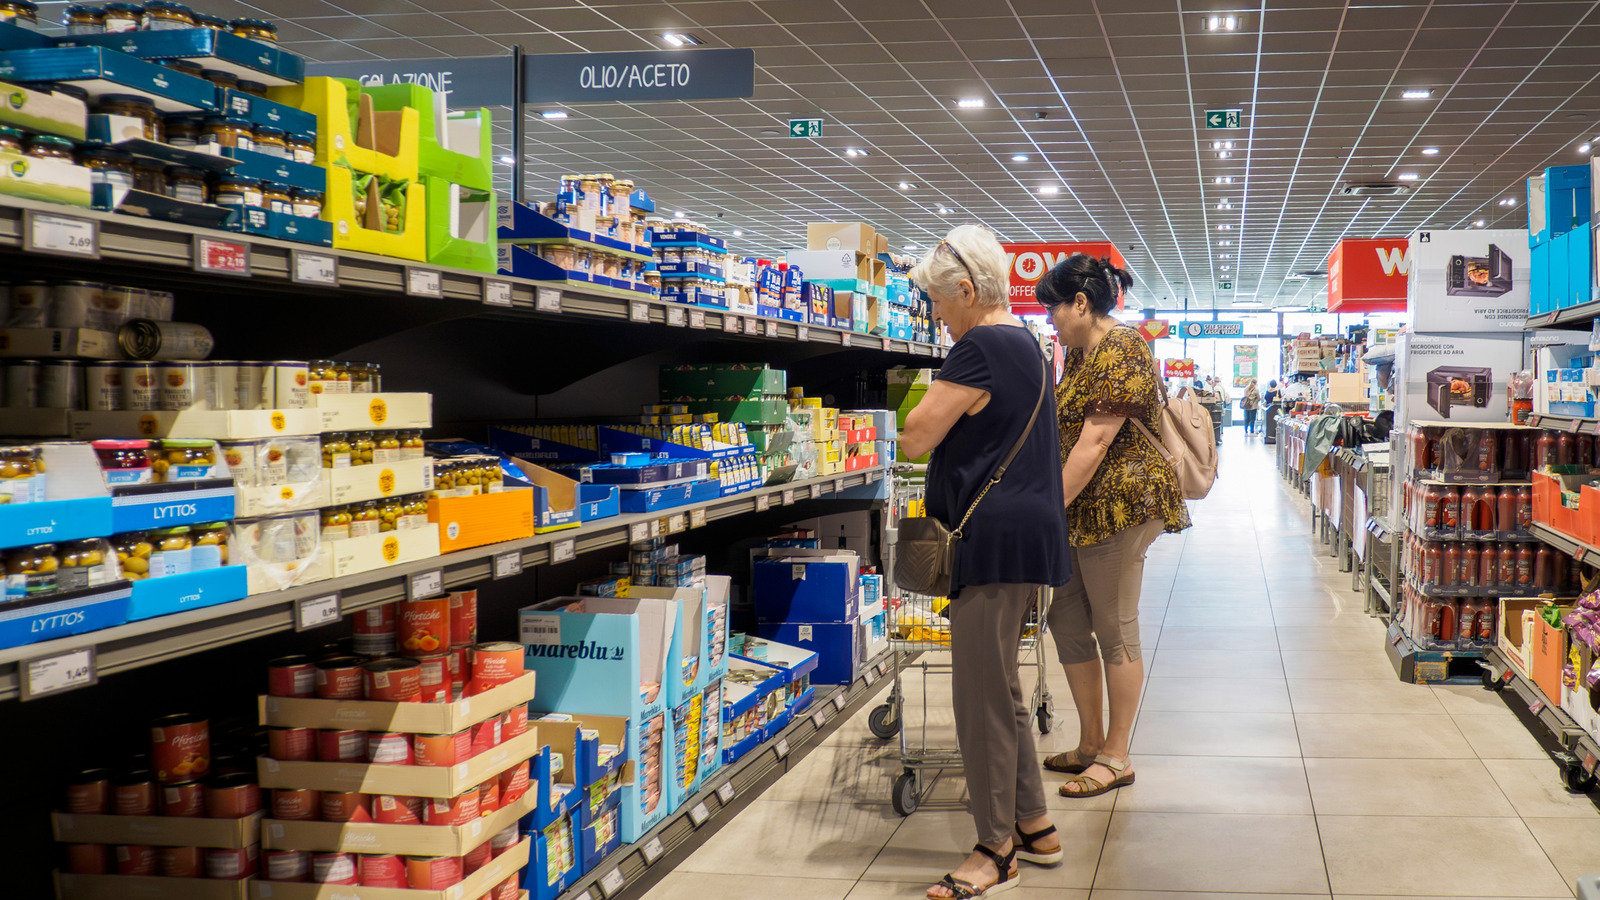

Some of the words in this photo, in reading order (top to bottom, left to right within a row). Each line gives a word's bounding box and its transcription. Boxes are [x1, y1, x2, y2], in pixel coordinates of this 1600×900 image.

[579, 63, 690, 88] OLIO/ACETO
[68, 235, 92, 247] 2,69
[226, 256, 245, 267] 2,19
[1169, 325, 1176, 334] 4
[1314, 325, 1321, 334] 2
[153, 503, 197, 519] LYTTOS
[27, 526, 53, 536] LYTTOS
[179, 593, 200, 604] LYTTOS
[30, 610, 85, 633] LYTTOS
[525, 640, 609, 660] Mareblu
[66, 666, 88, 680] 1,49
